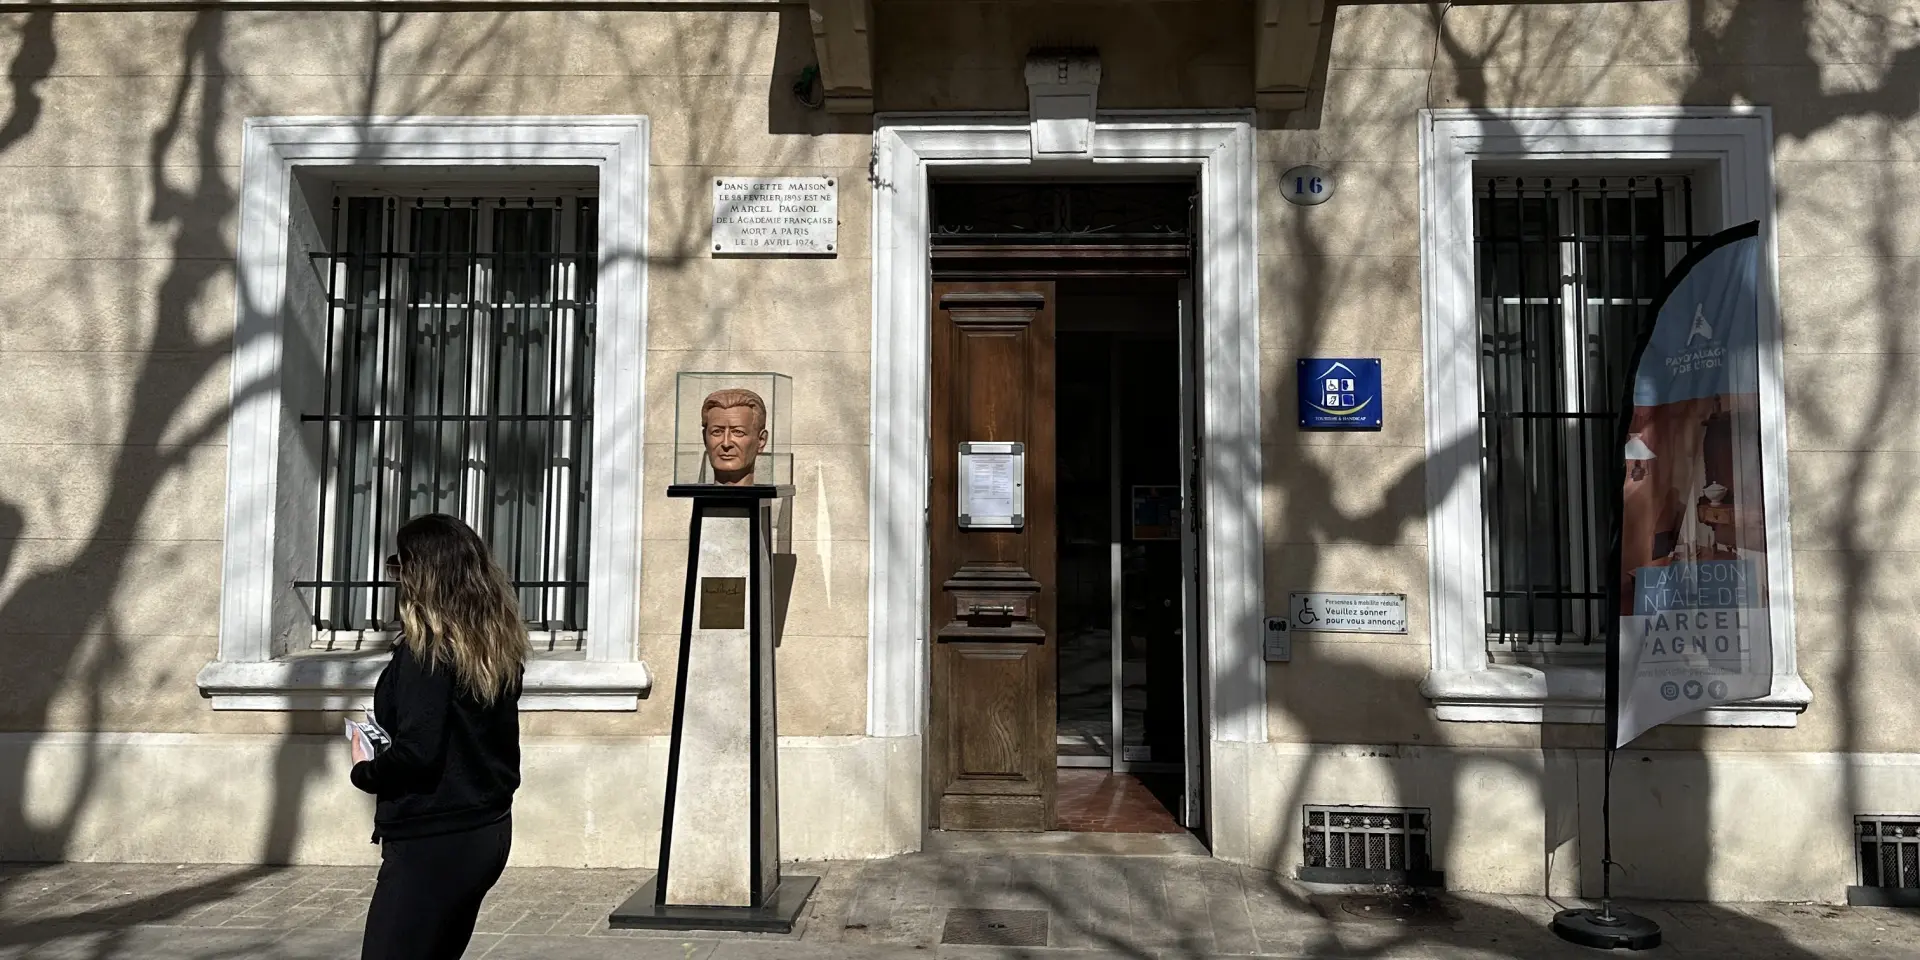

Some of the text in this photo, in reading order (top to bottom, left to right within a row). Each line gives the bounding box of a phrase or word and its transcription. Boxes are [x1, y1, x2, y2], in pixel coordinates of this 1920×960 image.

[724, 183, 827, 191] DANS CETTE MAISON
[1295, 177, 1323, 194] 16
[783, 194, 802, 202] 1895
[820, 193, 832, 201] NÉ
[730, 205, 820, 213] MARCEL PAGNOL
[784, 217, 833, 225] FRANÇAISE
[741, 228, 768, 236] MORT
[781, 228, 810, 236] PARIS
[764, 239, 792, 247] AVRIL
[795, 239, 814, 247] 1974
[1666, 563, 1746, 584] MAISON
[1644, 587, 1748, 612] NTALE DE
[1325, 607, 1357, 616] Veuillez
[1325, 617, 1344, 626] pour
[1645, 635, 1750, 656] AGNOL
